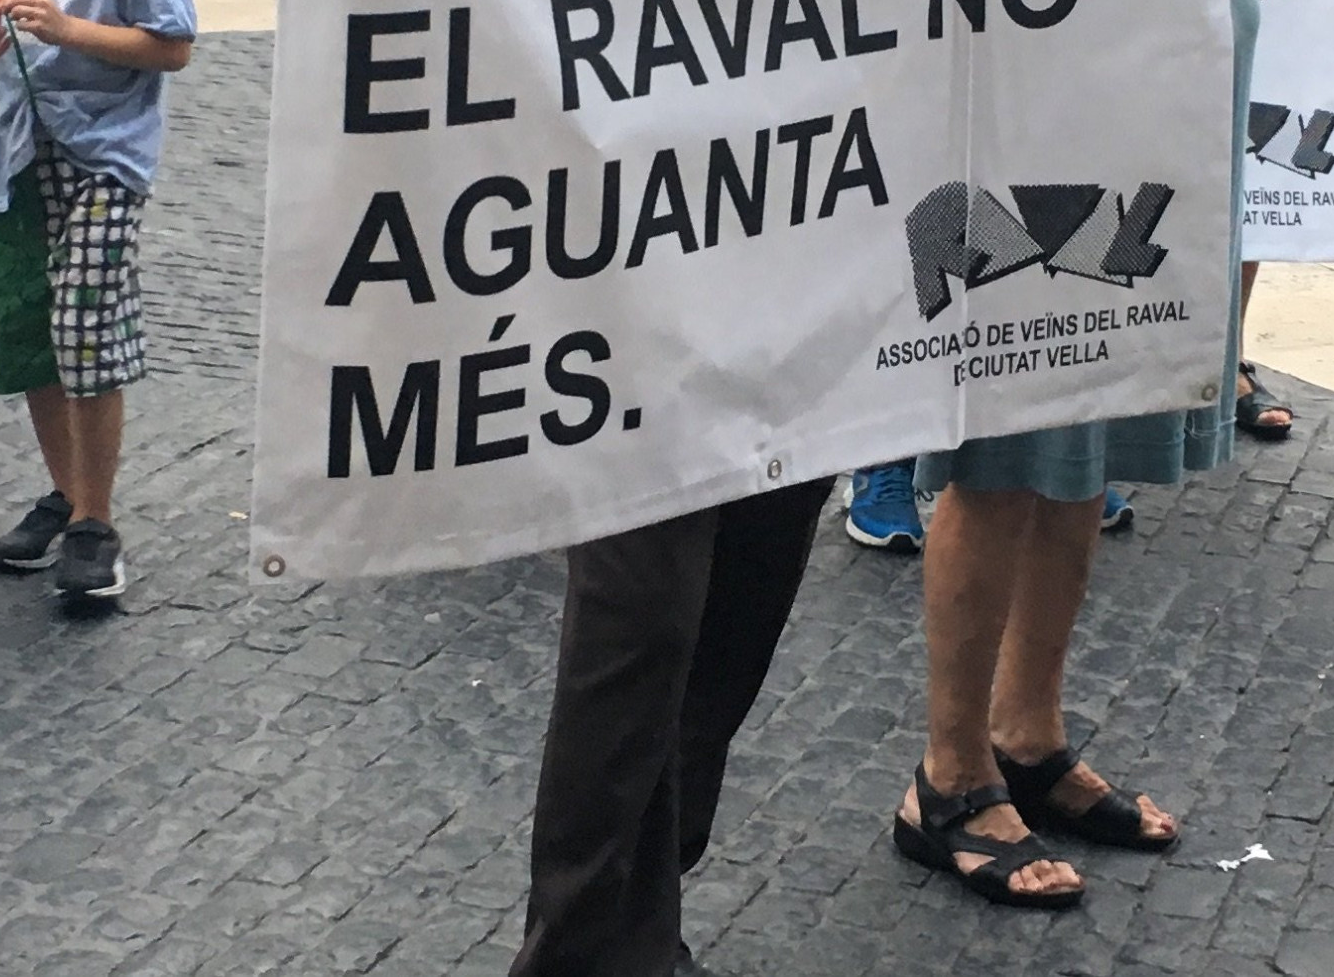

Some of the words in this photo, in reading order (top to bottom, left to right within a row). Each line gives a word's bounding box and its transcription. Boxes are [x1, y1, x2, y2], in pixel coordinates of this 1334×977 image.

[344, 7, 516, 133] EL
[325, 107, 889, 307] AGUANTA
[1262, 211, 1302, 226] VELLA
[1283, 191, 1309, 206] DEL
[875, 320, 981, 371] ASSOCIAÓ
[986, 322, 1014, 347] DE
[1020, 311, 1078, 343] VEÏNS
[1084, 308, 1121, 334] DEL
[1126, 300, 1190, 327] RAVAL
[968, 349, 1041, 379] CIUTAT
[1046, 340, 1109, 370] VELLA
[328, 314, 642, 478] MÉS.
